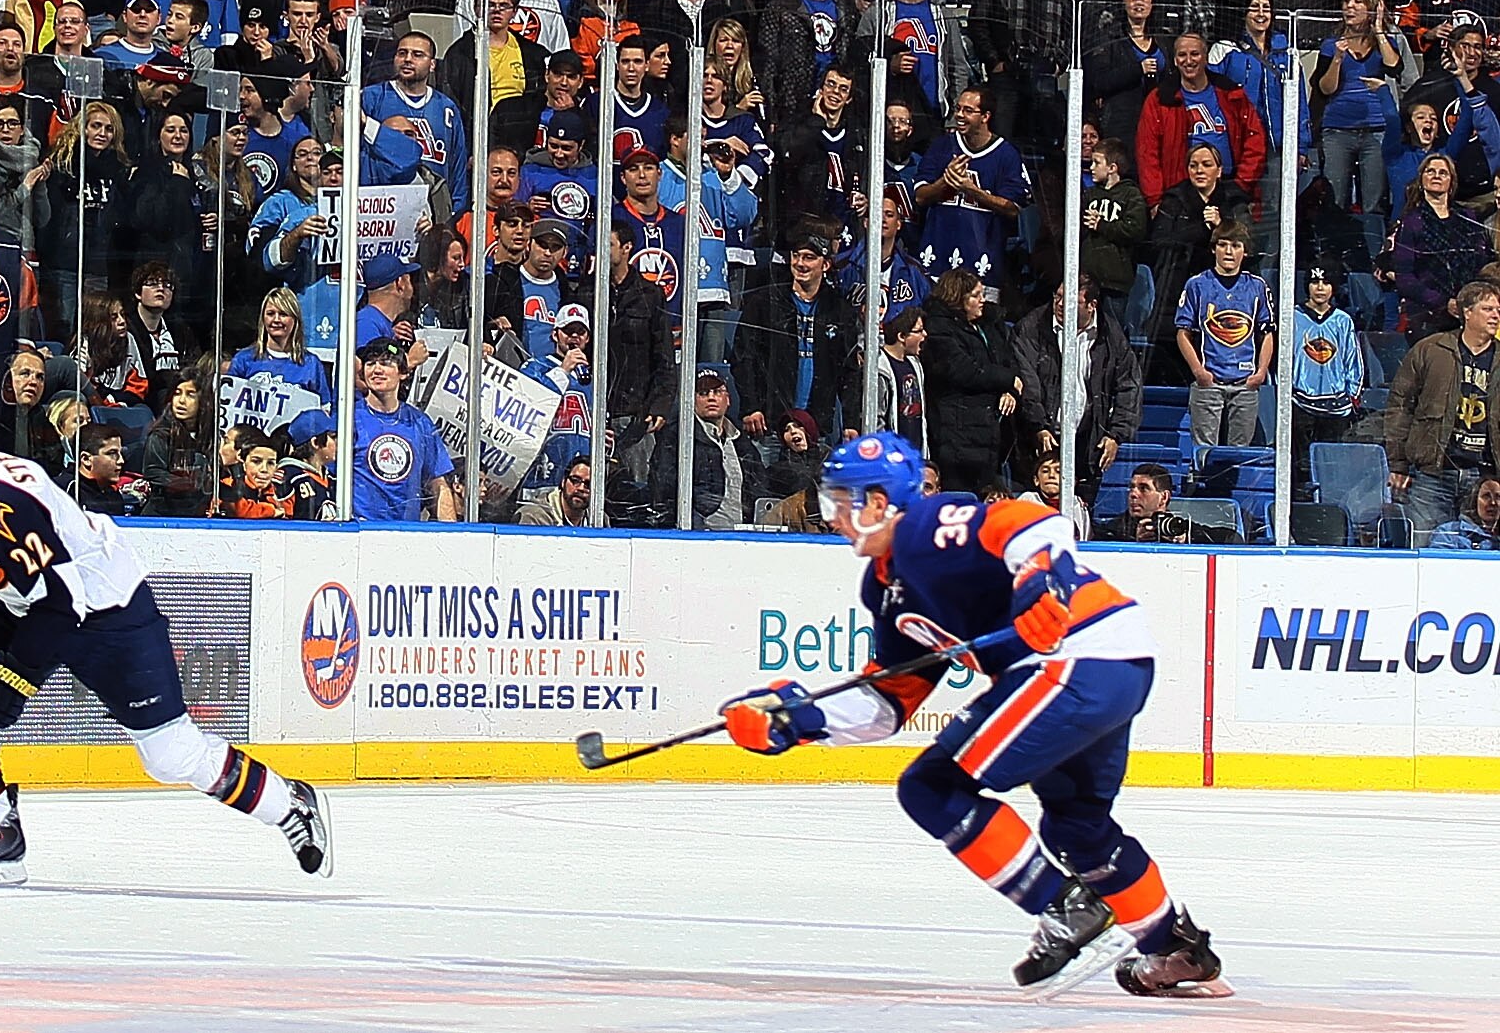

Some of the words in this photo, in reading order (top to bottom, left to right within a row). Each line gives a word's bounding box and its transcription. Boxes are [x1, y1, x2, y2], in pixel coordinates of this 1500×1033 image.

[444, 107, 455, 128] C
[482, 361, 518, 392] THE
[494, 388, 546, 439] WAVE
[494, 428, 516, 447] CITY
[299, 481, 316, 499] 91
[933, 504, 978, 549] 36
[9, 531, 55, 576] 22
[368, 584, 433, 637] DON'T
[438, 585, 499, 639] MISS
[507, 588, 524, 639] A
[531, 588, 620, 640] SHIFT!
[1252, 607, 1500, 675] NHL.CO
[369, 646, 476, 675] ISLANDERS
[486, 647, 561, 675] TICKET
[575, 649, 646, 677] PLANS
[368, 682, 574, 709] 1.800.882.ISLES
[583, 686, 644, 710] EXT
